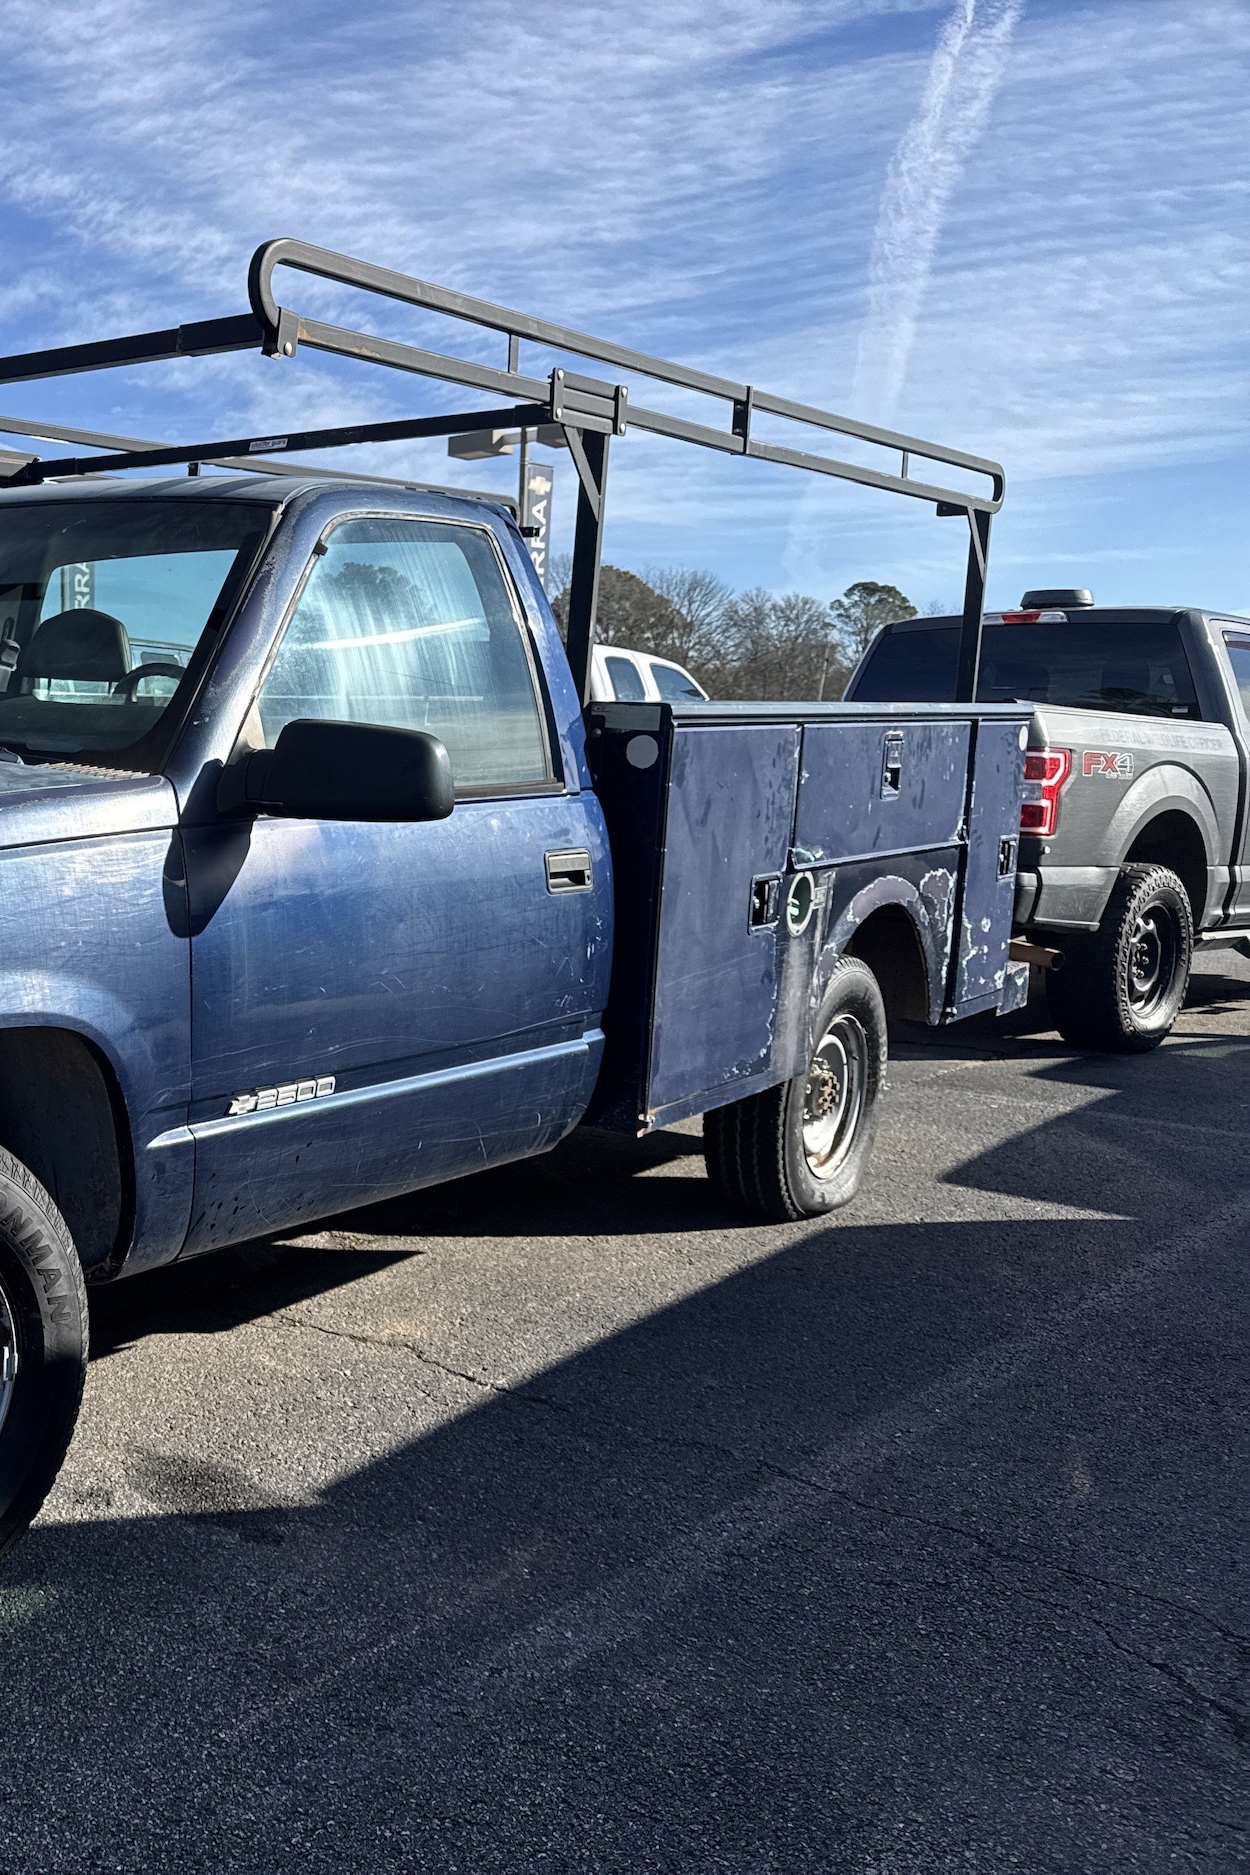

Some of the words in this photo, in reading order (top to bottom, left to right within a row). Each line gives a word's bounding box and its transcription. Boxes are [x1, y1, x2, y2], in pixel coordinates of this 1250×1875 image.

[531, 499, 547, 586] RRA
[1082, 750, 1134, 776] FX4
[256, 1076, 336, 1110] 2500
